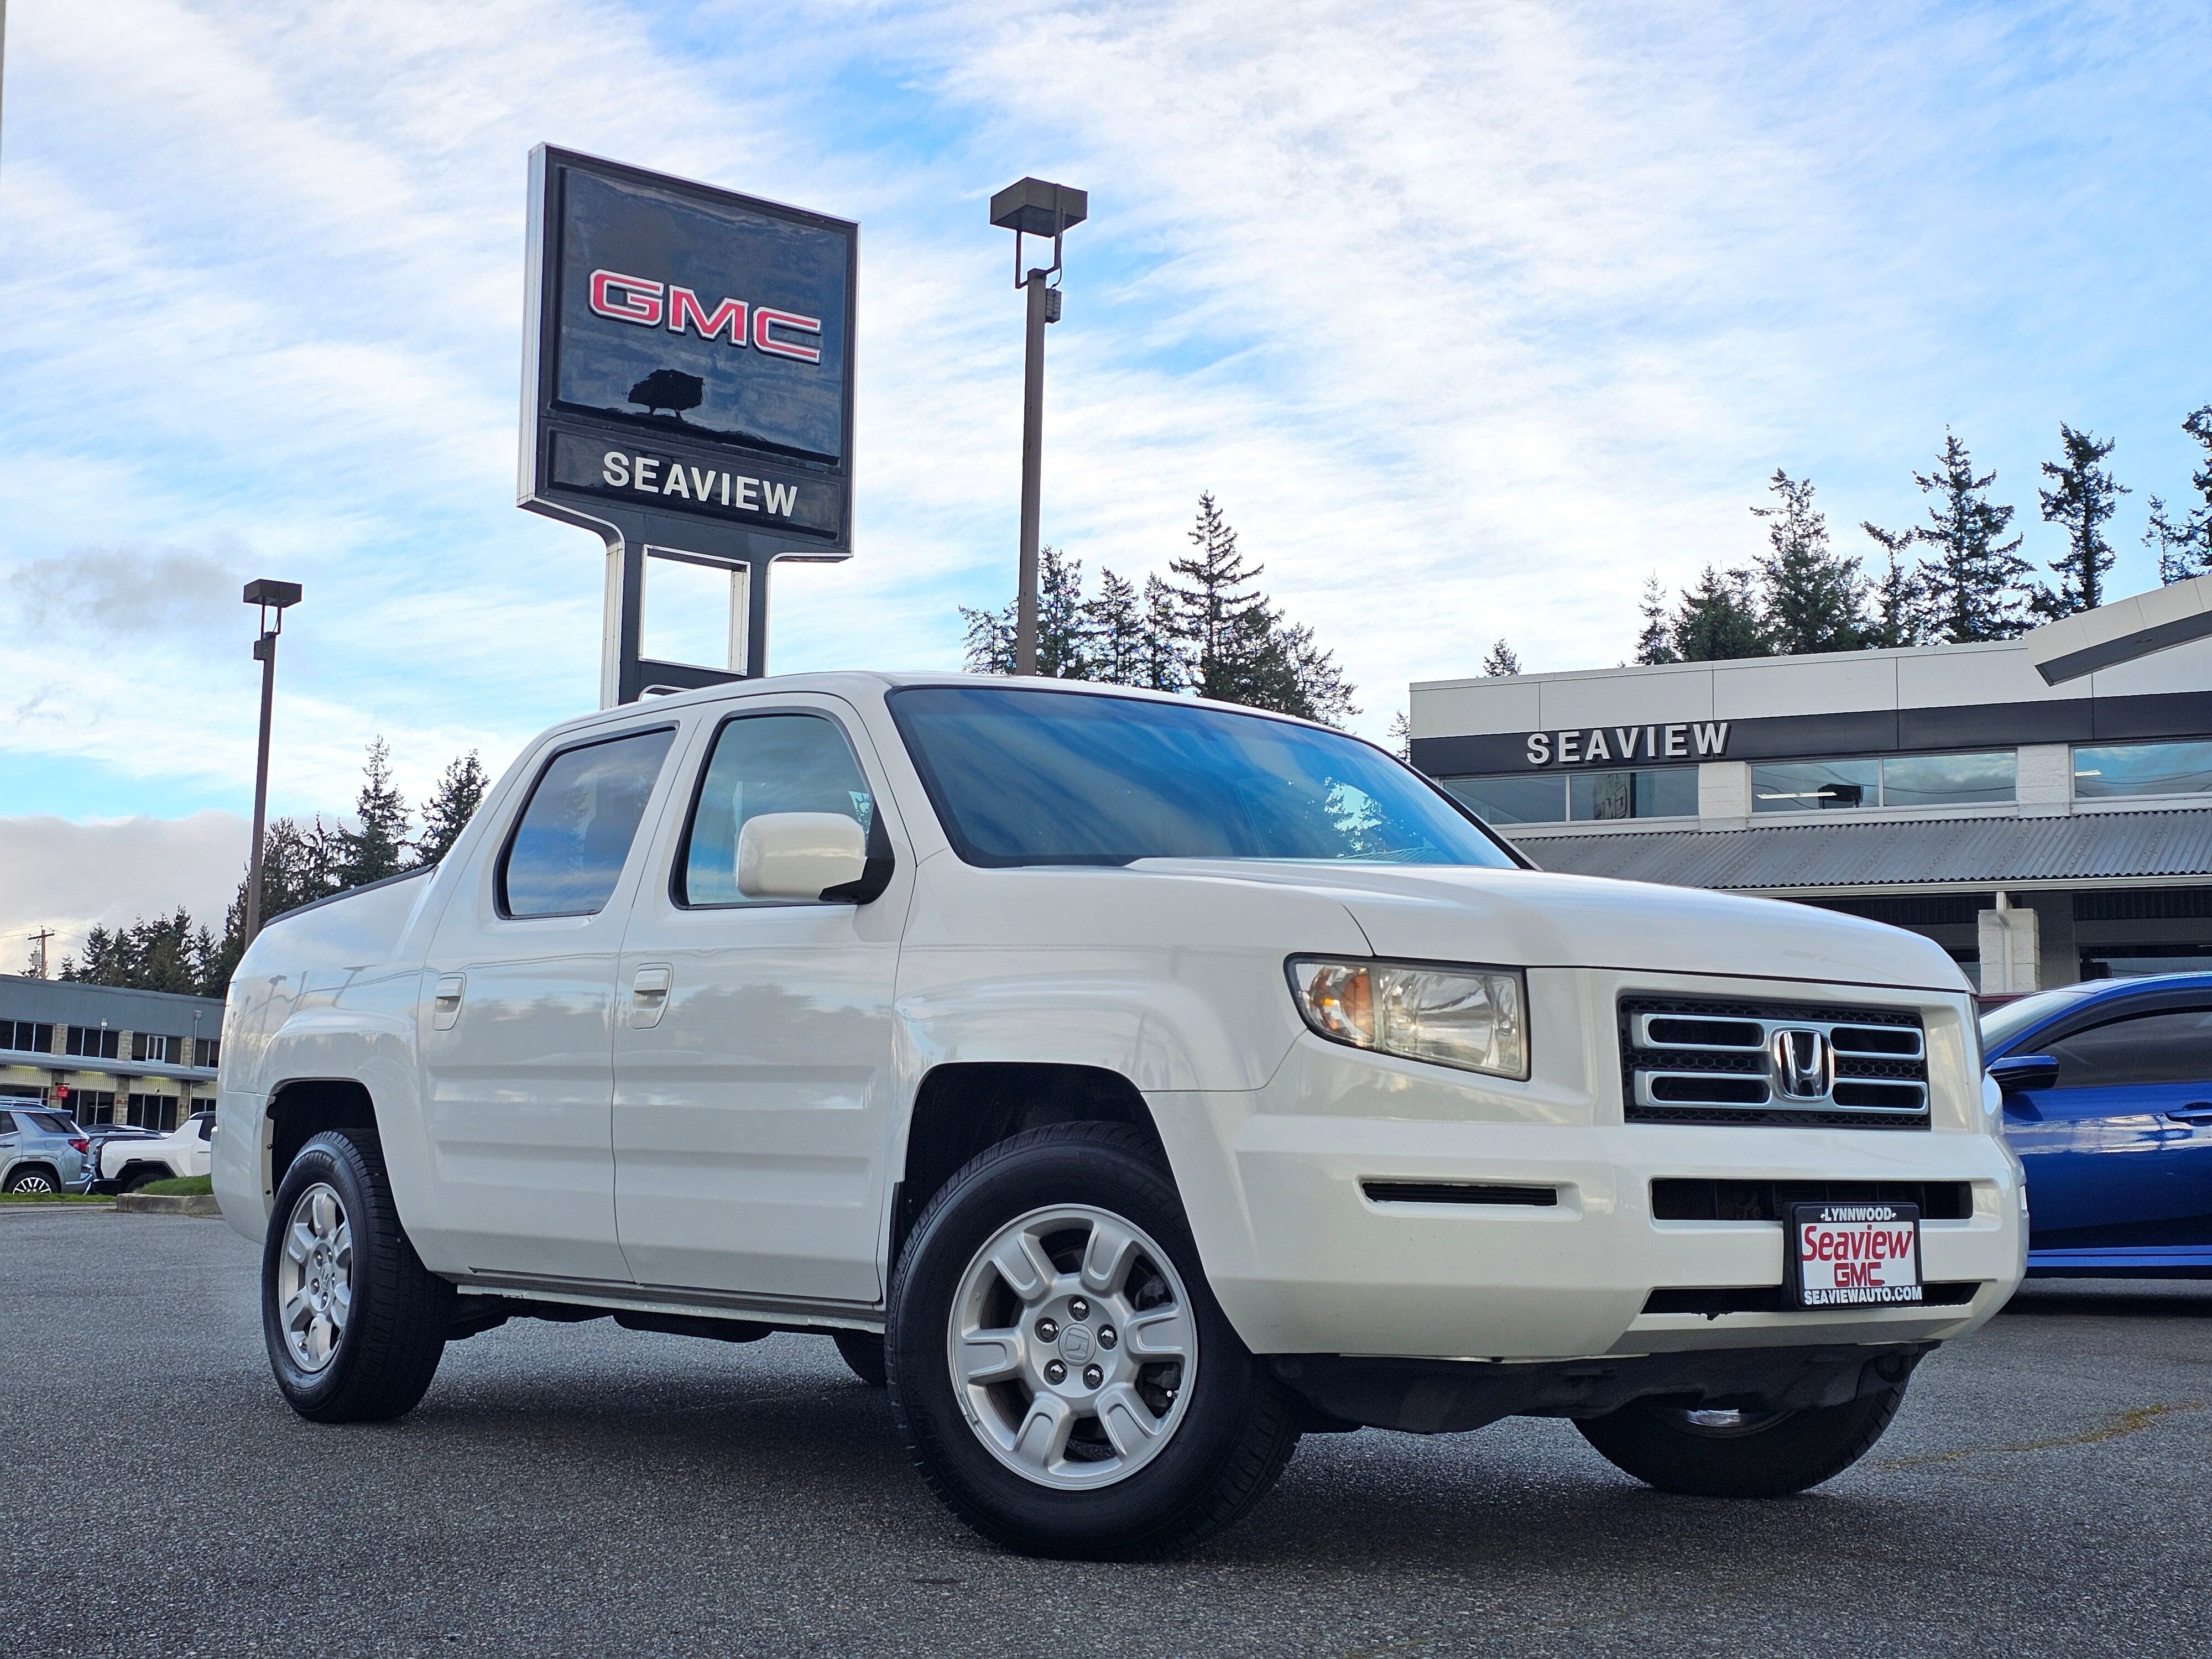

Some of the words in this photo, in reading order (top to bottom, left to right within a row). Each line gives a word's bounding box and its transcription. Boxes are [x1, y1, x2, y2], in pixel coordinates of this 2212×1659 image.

[589, 269, 821, 363] GMC
[603, 451, 797, 517] SEAVIEW
[1527, 722, 1730, 765] SEAVIEW
[1824, 1207, 1892, 1221] LYNNWOOD
[1801, 1224, 1913, 1261] Seaview
[1833, 1261, 1885, 1287] GMC
[1804, 1286, 1922, 1305] SEAVIEWAUTO.COM
